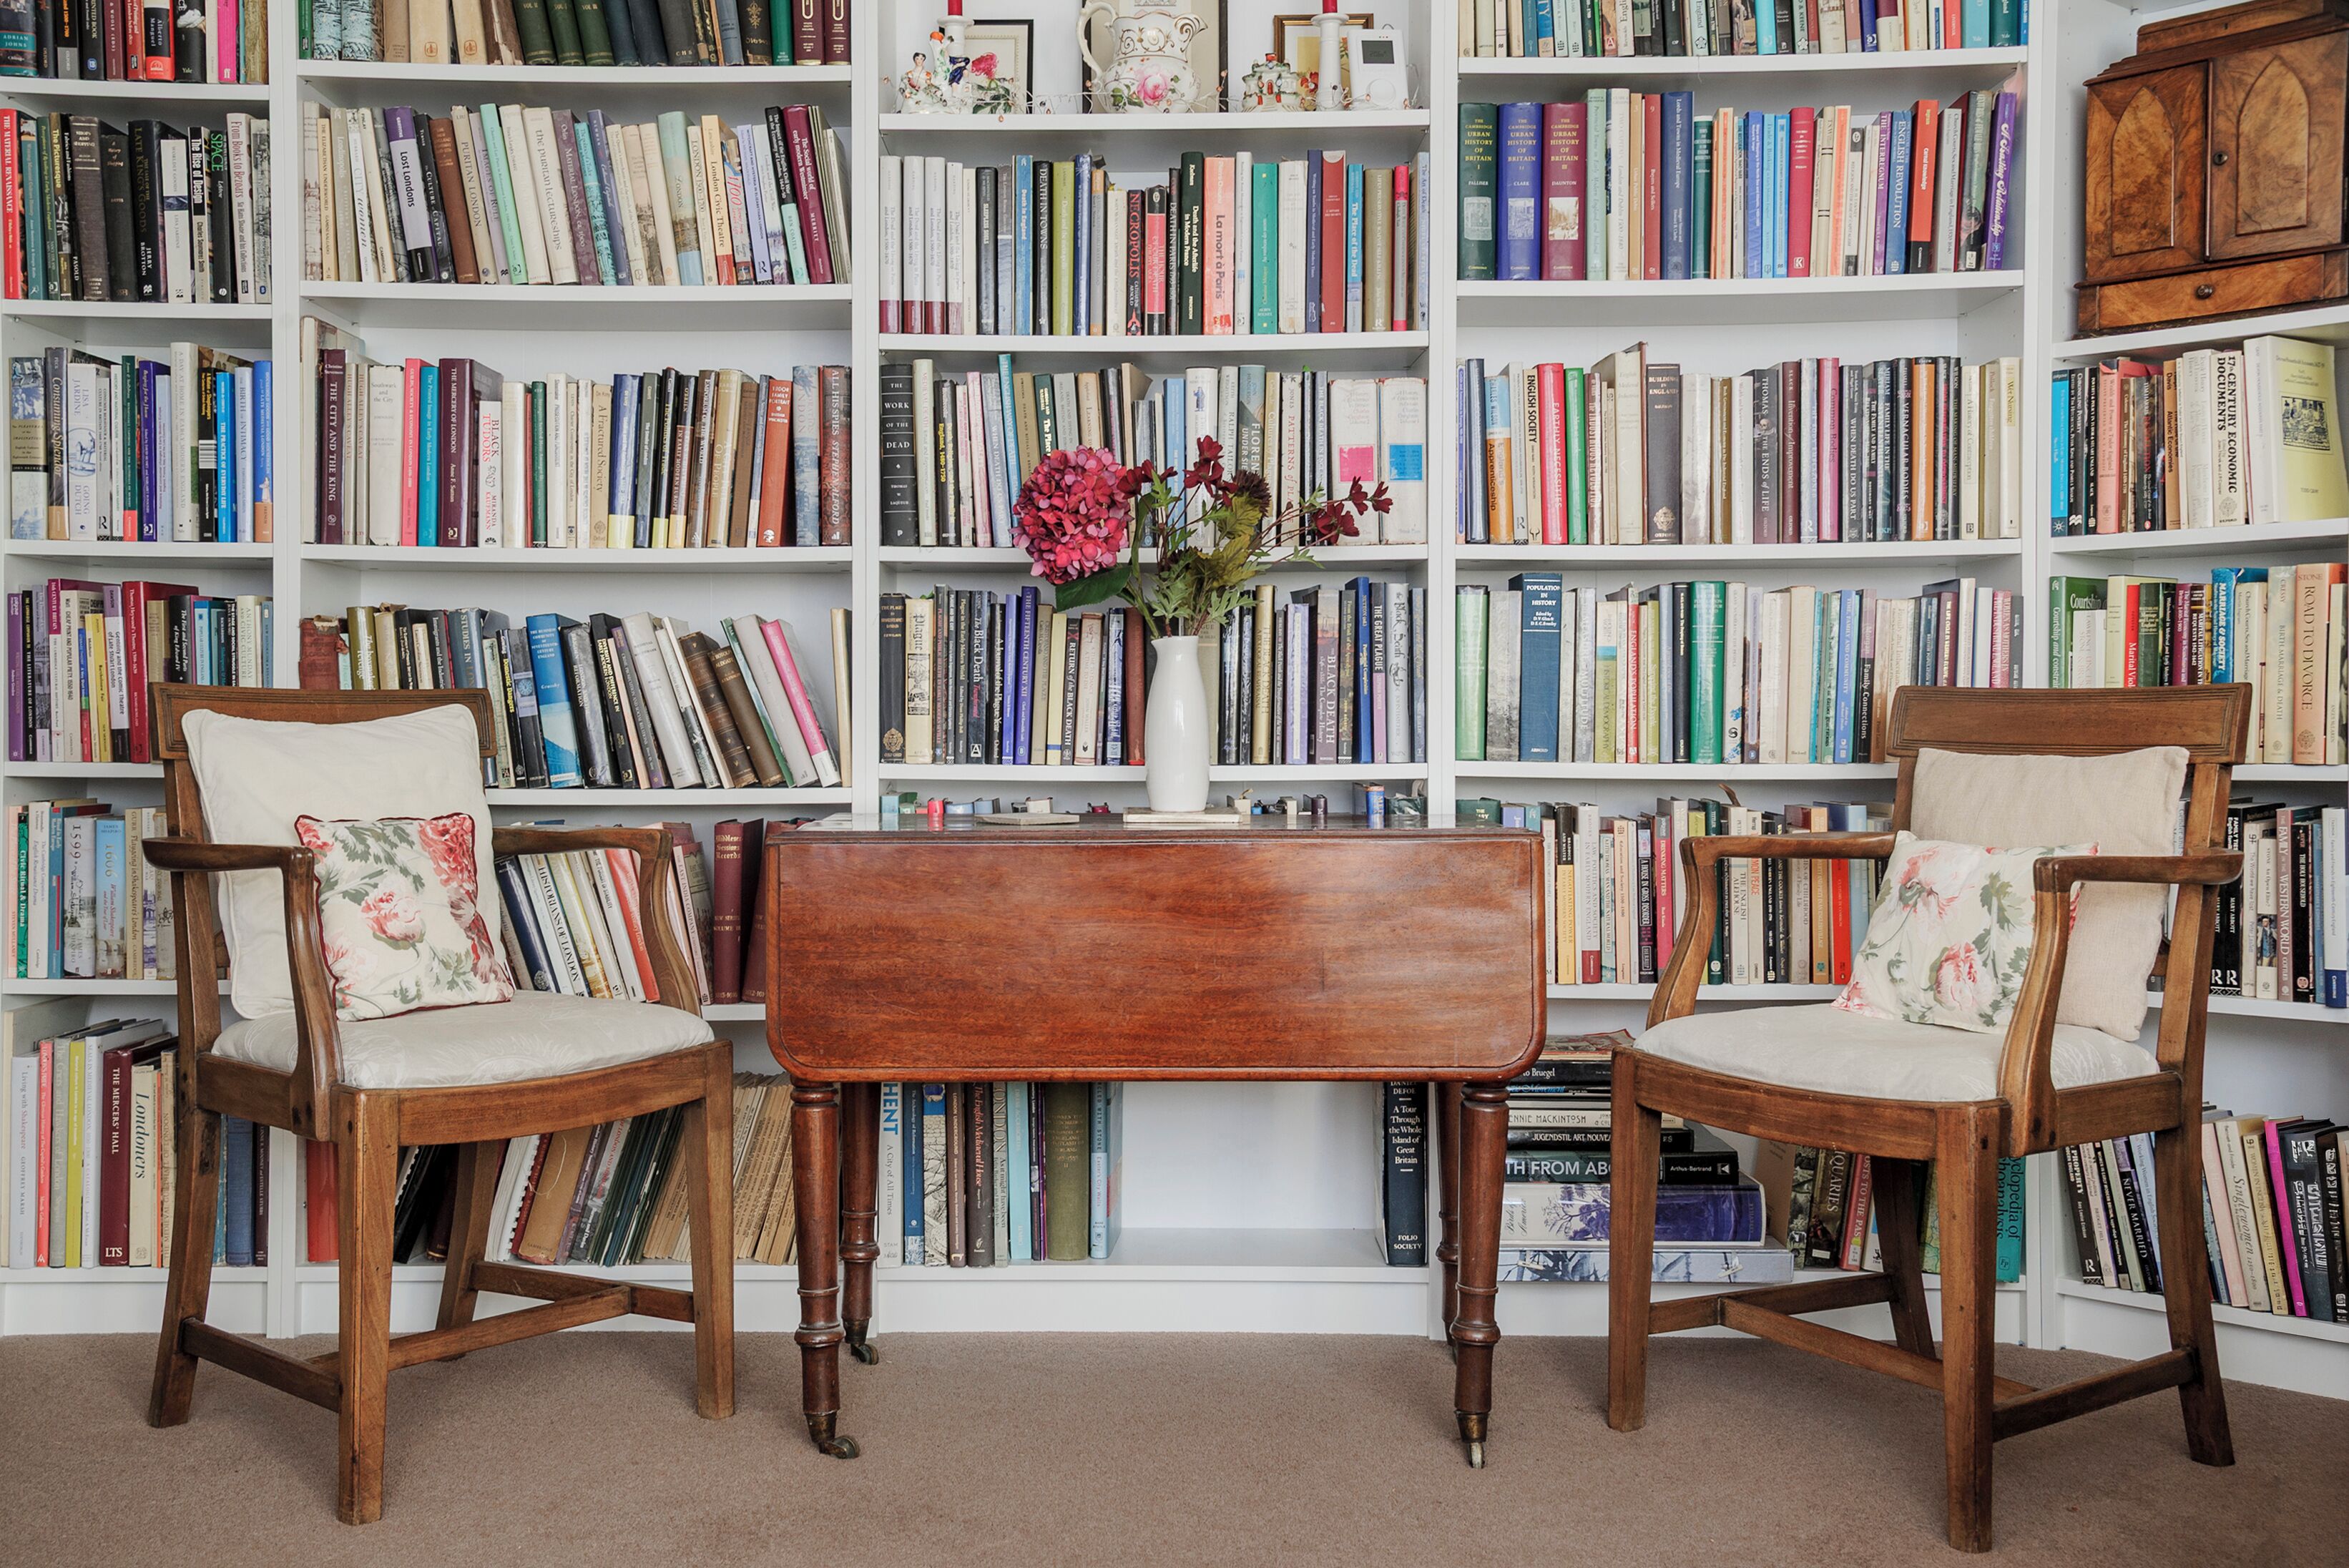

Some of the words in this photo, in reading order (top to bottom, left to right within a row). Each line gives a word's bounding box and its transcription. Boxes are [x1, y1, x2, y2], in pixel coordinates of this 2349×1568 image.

[191, 139, 202, 151] The
[231, 121, 242, 139] From
[1897, 121, 1906, 163] ENGLISH
[192, 153, 202, 168] Rise
[211, 134, 223, 171] SPACE
[233, 141, 242, 161] Books
[401, 152, 412, 170] Lost
[1878, 134, 1886, 189] INTERREGNUM
[192, 180, 202, 203] Design
[235, 171, 244, 198] Bezoars
[403, 172, 416, 207] Londons
[461, 142, 474, 182] PURITAN
[469, 187, 481, 227] LONDON
[710, 161, 721, 192] London
[714, 194, 722, 214] Civic
[1893, 165, 1903, 227] REVOLUTION
[715, 216, 726, 247] Theatre
[1129, 193, 1140, 278] NECROPOLIS
[1215, 215, 1225, 228] La
[1215, 230, 1225, 259] mort
[1215, 272, 1225, 299] Paris
[52, 378, 62, 431] Consuming
[1527, 375, 1536, 408] ENGLISH
[2227, 373, 2237, 428] CENTURY
[597, 415, 608, 456] Fractured
[52, 433, 63, 476] Splendor
[2227, 431, 2237, 493] ECONOMIC
[596, 459, 607, 492] Society
[1285, 475, 1295, 484] of
[1488, 444, 1497, 511] Apprenticeship
[2304, 586, 2315, 624] ROAD
[2303, 626, 2314, 646] TO
[503, 658, 511, 685] Domestic
[1327, 655, 1336, 695] BLACK
[1862, 664, 1871, 689] Family
[2302, 650, 2313, 710] DIVORCE
[506, 687, 515, 712] Dangers
[1326, 700, 1335, 743] DEATH
[72, 824, 81, 858] 1599
[2279, 827, 2288, 854] FAMILY
[105, 843, 117, 877] 1606
[538, 866, 561, 925] HISTORIANS
[2280, 875, 2289, 917] WESTERN
[556, 926, 567, 939] OF
[685, 903, 696, 934] COMPANY
[2280, 920, 2290, 954] WORLD
[561, 941, 581, 981] LONDON
[975, 1086, 984, 1099] The
[974, 1100, 984, 1124] English
[1391, 1115, 1420, 1124] Through
[1536, 1115, 1586, 1124] MACKINTOSH
[134, 1093, 148, 1179] Londoners
[976, 1125, 984, 1163] Mediaeval
[885, 1153, 894, 1167] City
[976, 1165, 984, 1186] House
[1531, 1161, 1580, 1175] FROM
[2071, 1150, 2083, 1195] PROPERTY
[2122, 1178, 2134, 1210] NEVER
[2129, 1212, 2147, 1258] MARRIED
[2232, 1177, 2255, 1255] Singlewomen
[106, 1248, 122, 1257] LTS
